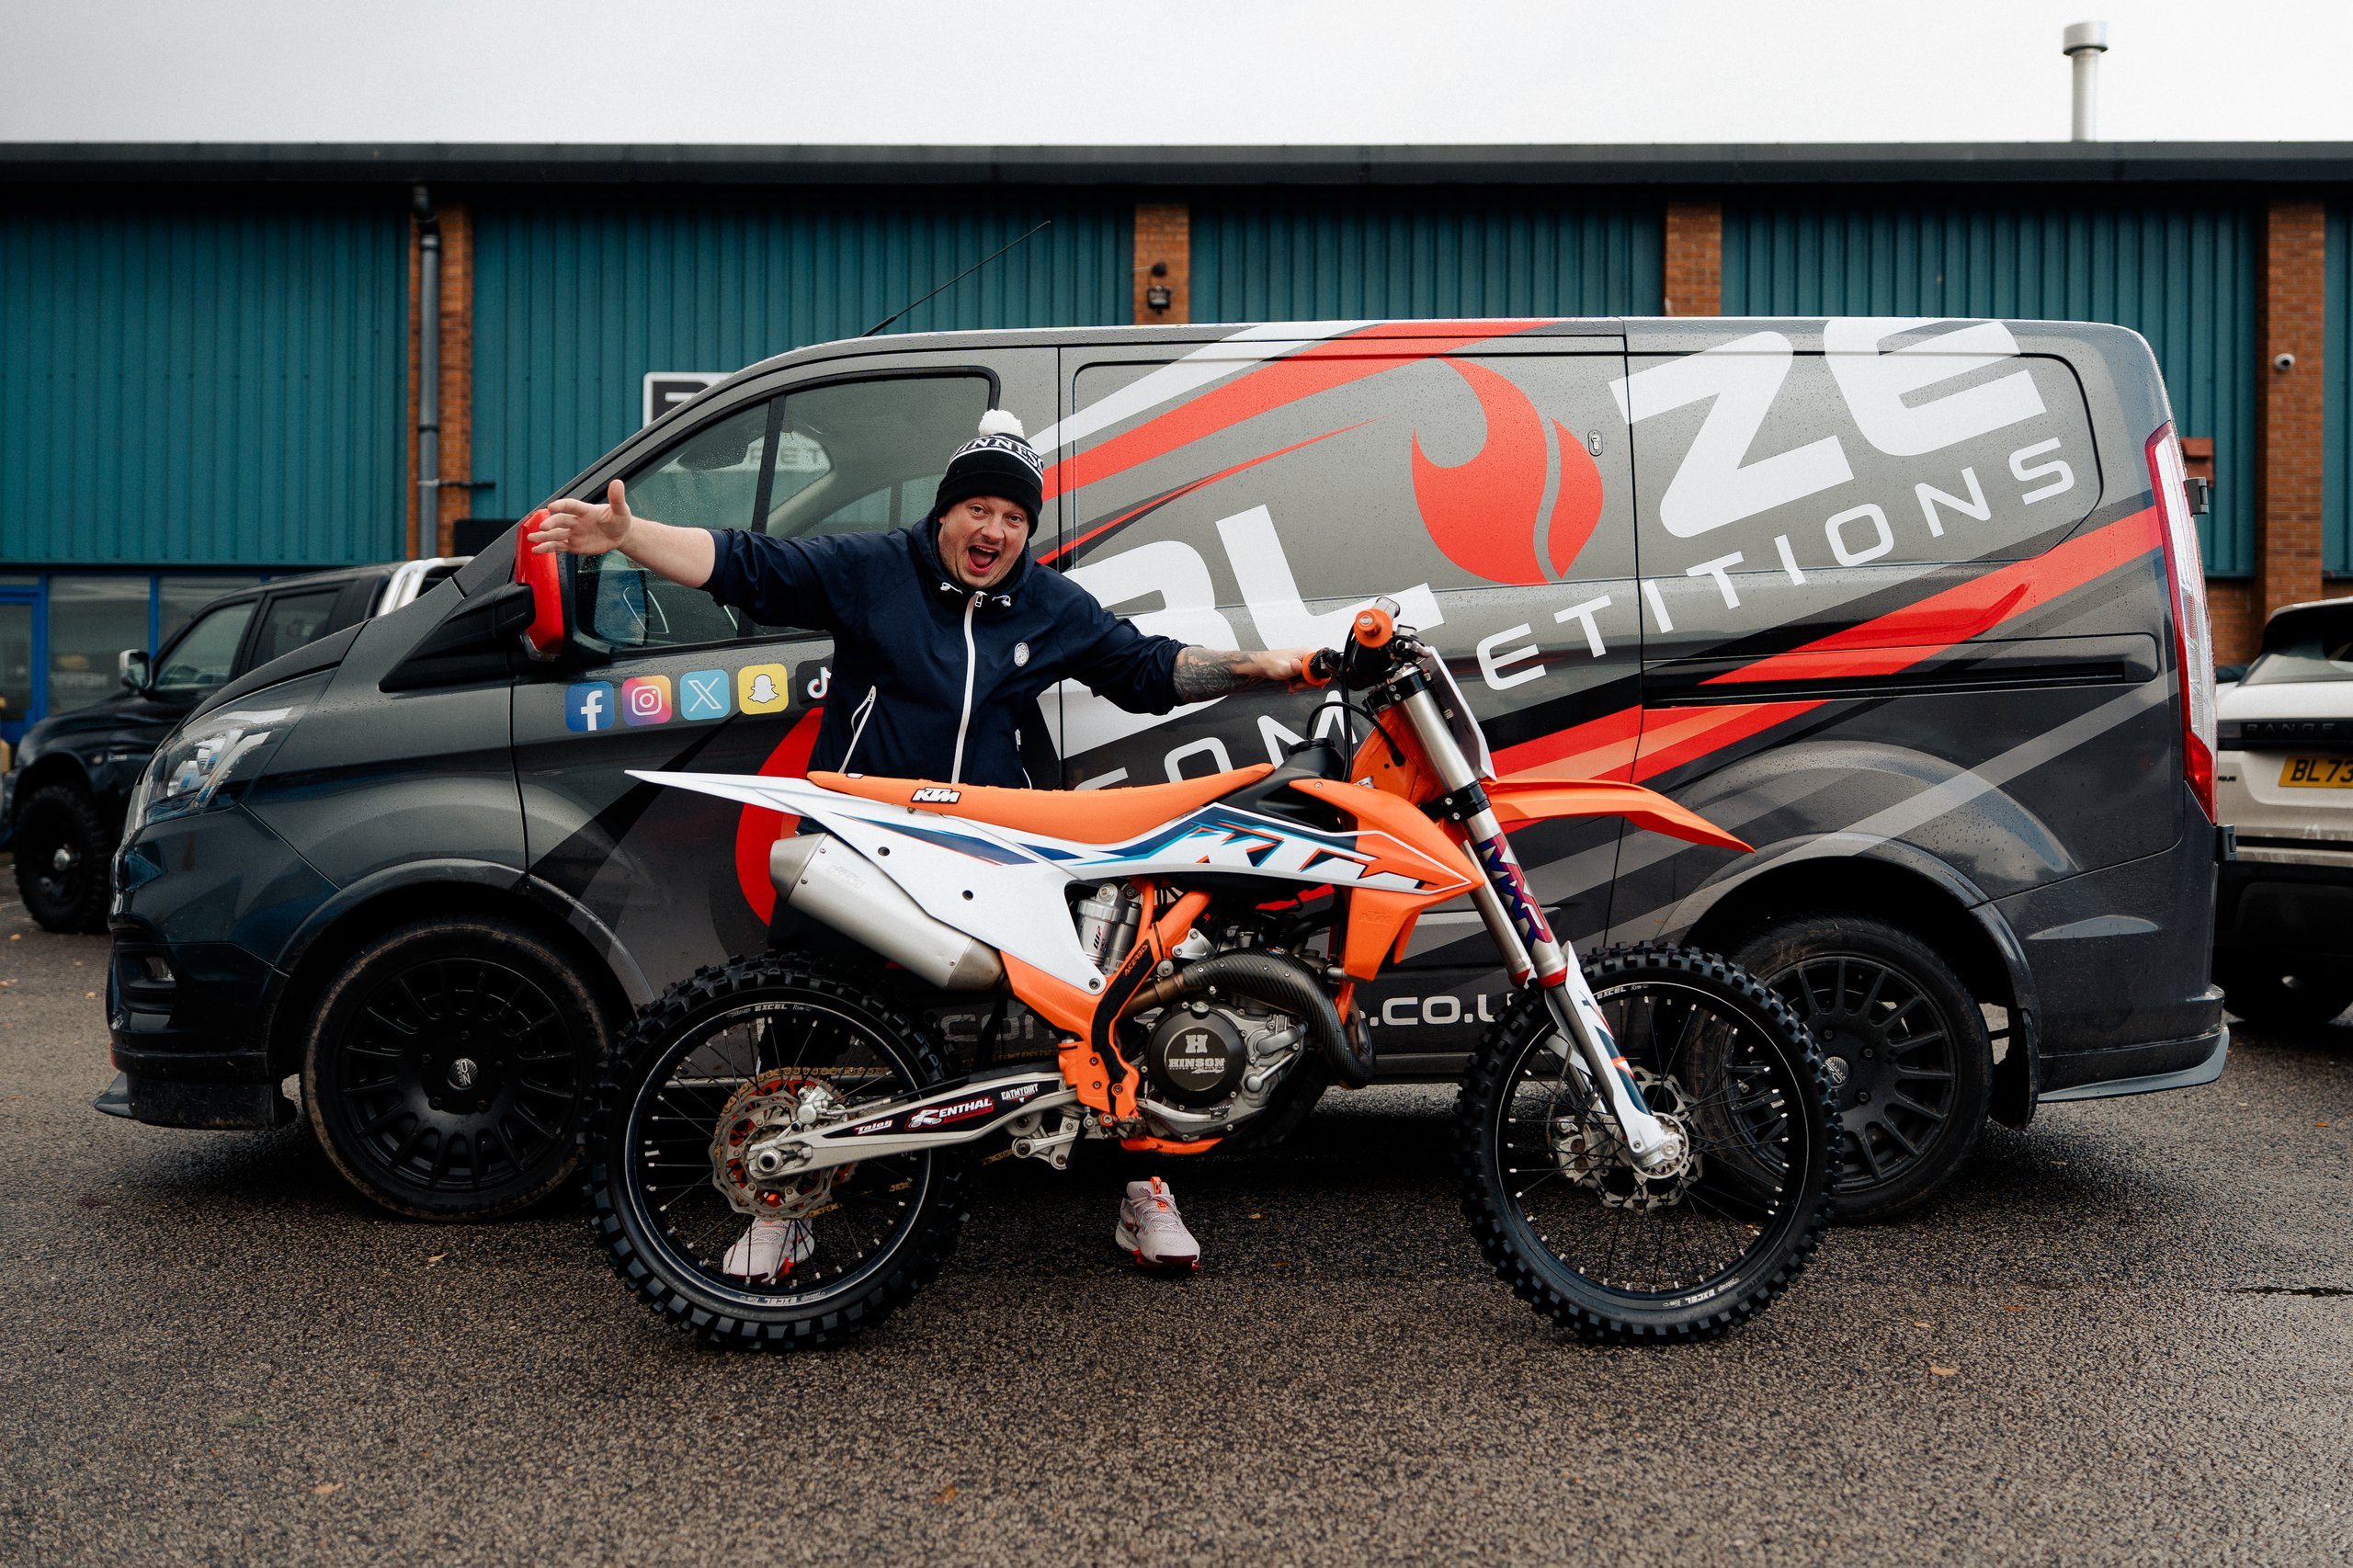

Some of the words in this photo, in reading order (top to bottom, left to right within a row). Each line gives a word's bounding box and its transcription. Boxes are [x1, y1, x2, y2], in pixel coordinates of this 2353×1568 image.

[2246, 722, 2335, 735] RANGE
[2290, 759, 2353, 782] BL73
[912, 788, 961, 802] KTM
[755, 1004, 788, 1012] EXCEL
[1185, 1034, 1209, 1054] H
[1168, 1057, 1226, 1069] HINSON
